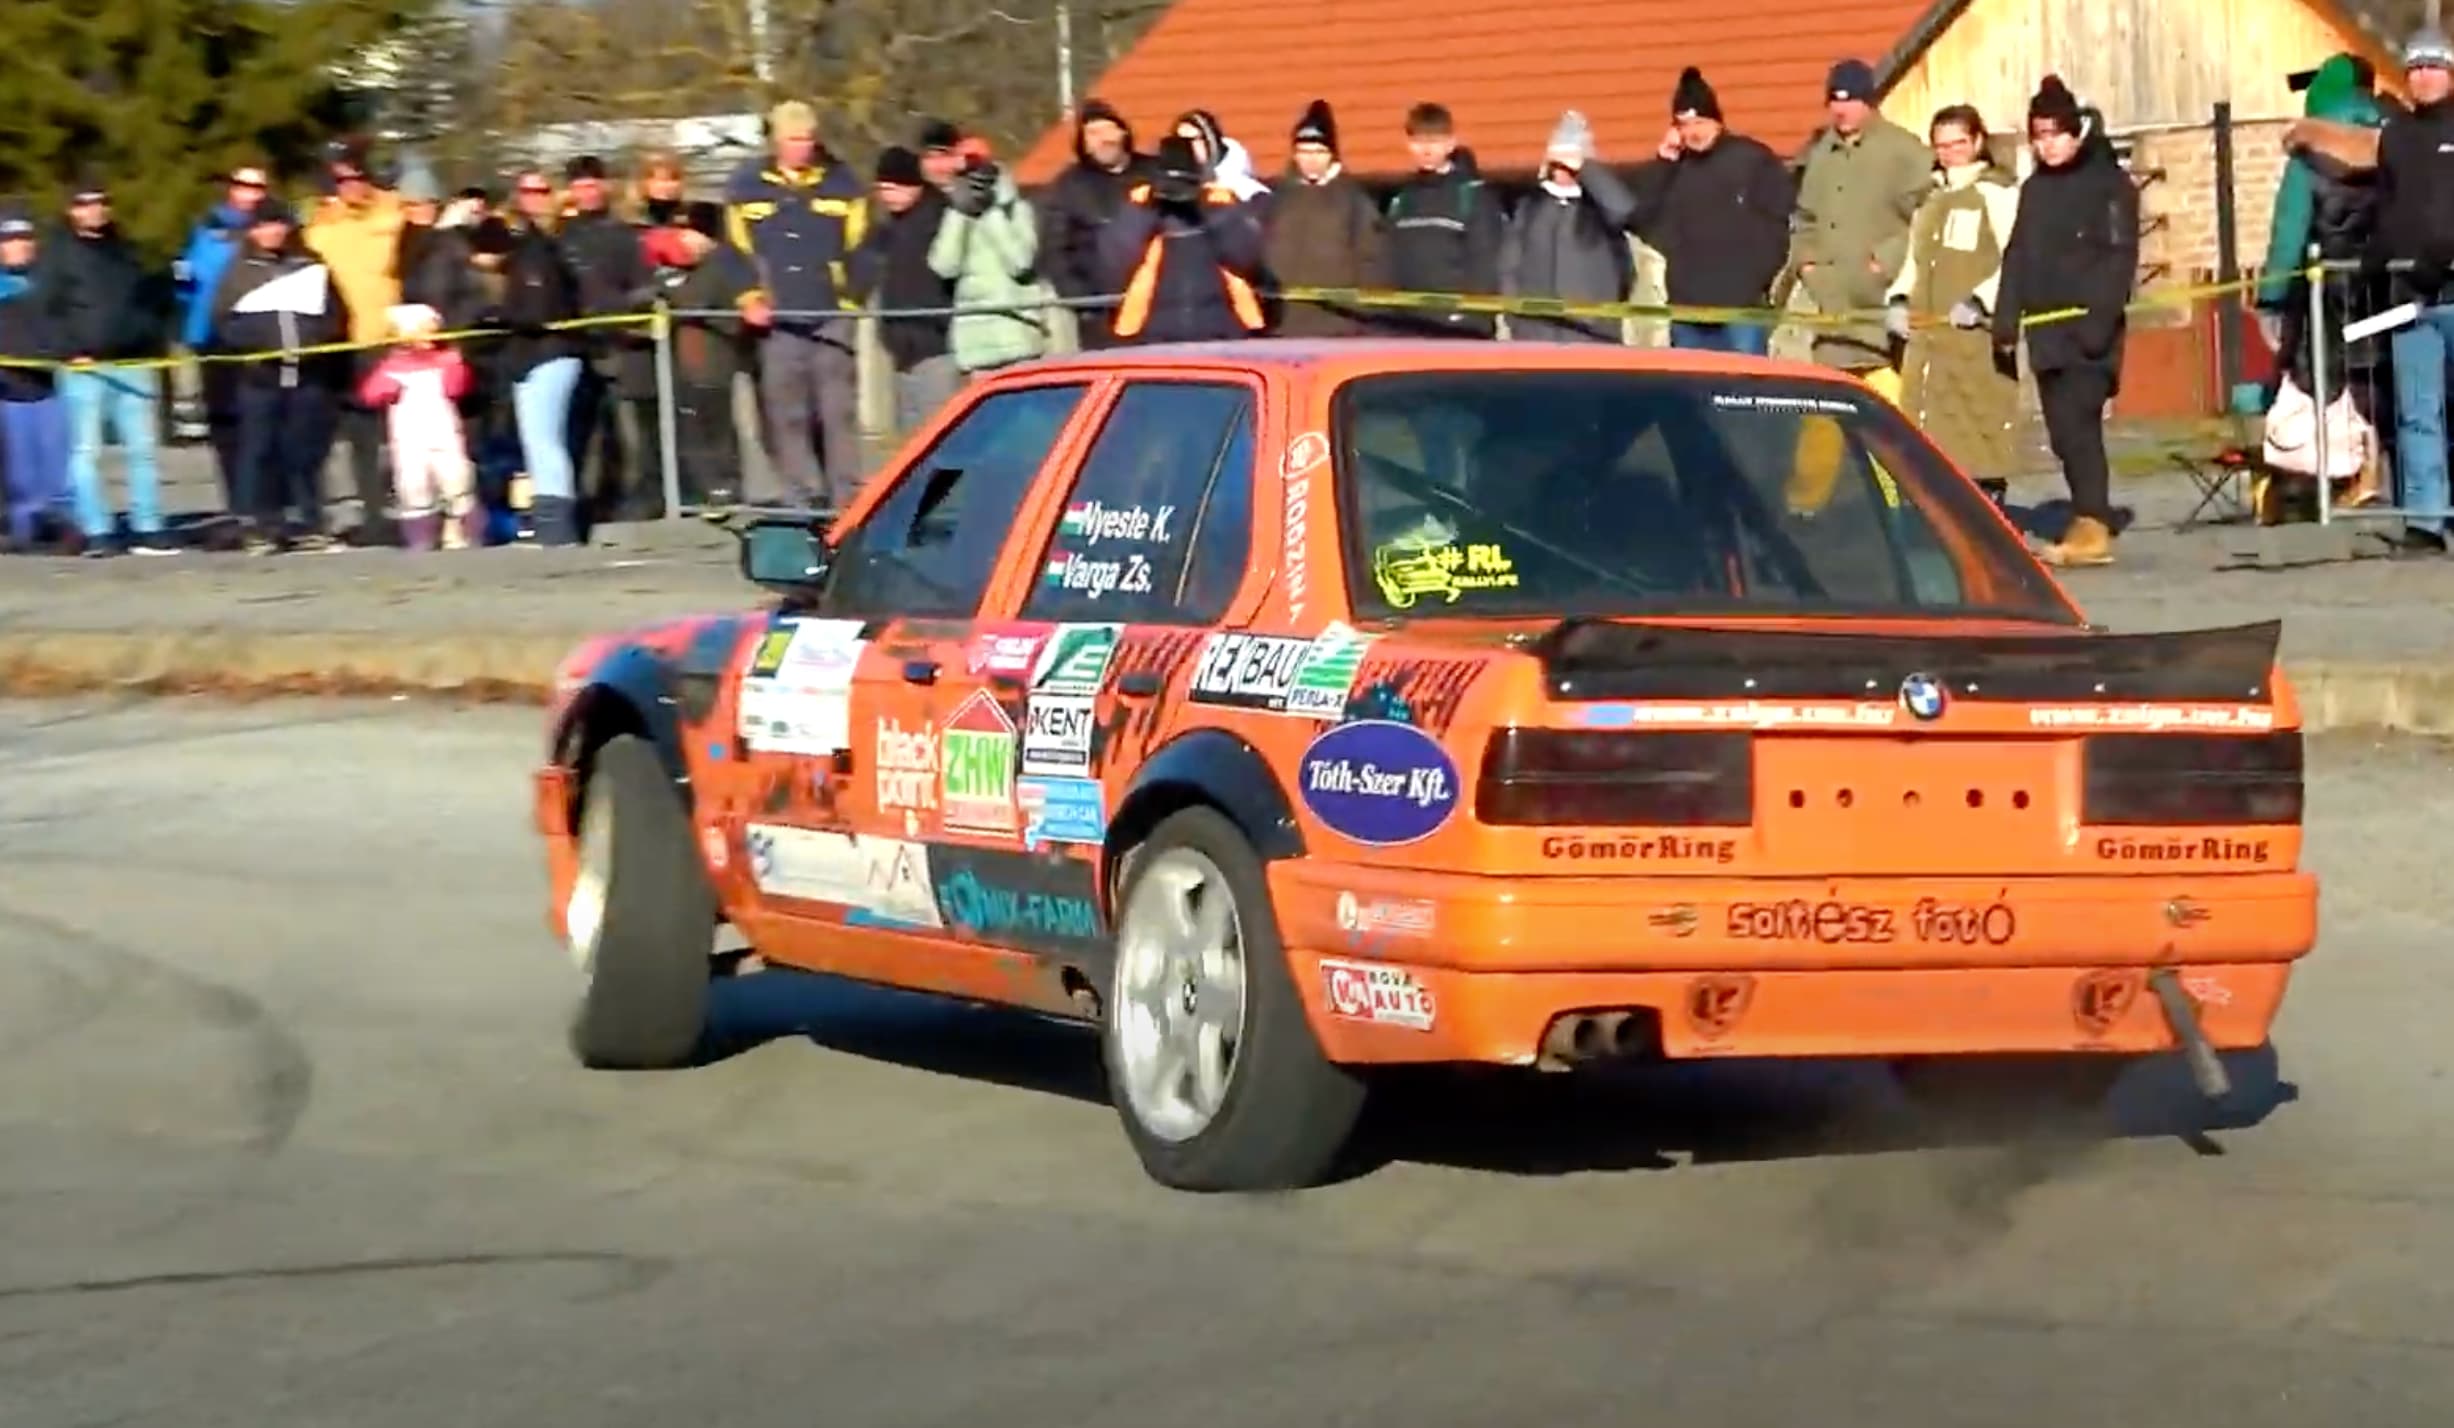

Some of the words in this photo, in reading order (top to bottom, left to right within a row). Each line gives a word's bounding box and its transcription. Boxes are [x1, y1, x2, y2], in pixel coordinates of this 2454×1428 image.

[1084, 500, 1149, 546] Nyeste
[1149, 505, 1176, 544] K.
[1062, 552, 1121, 599] Varga
[1118, 554, 1153, 594] Zs.
[1308, 759, 1407, 796] Tóth-Szer
[1406, 766, 1451, 808] Kft.
